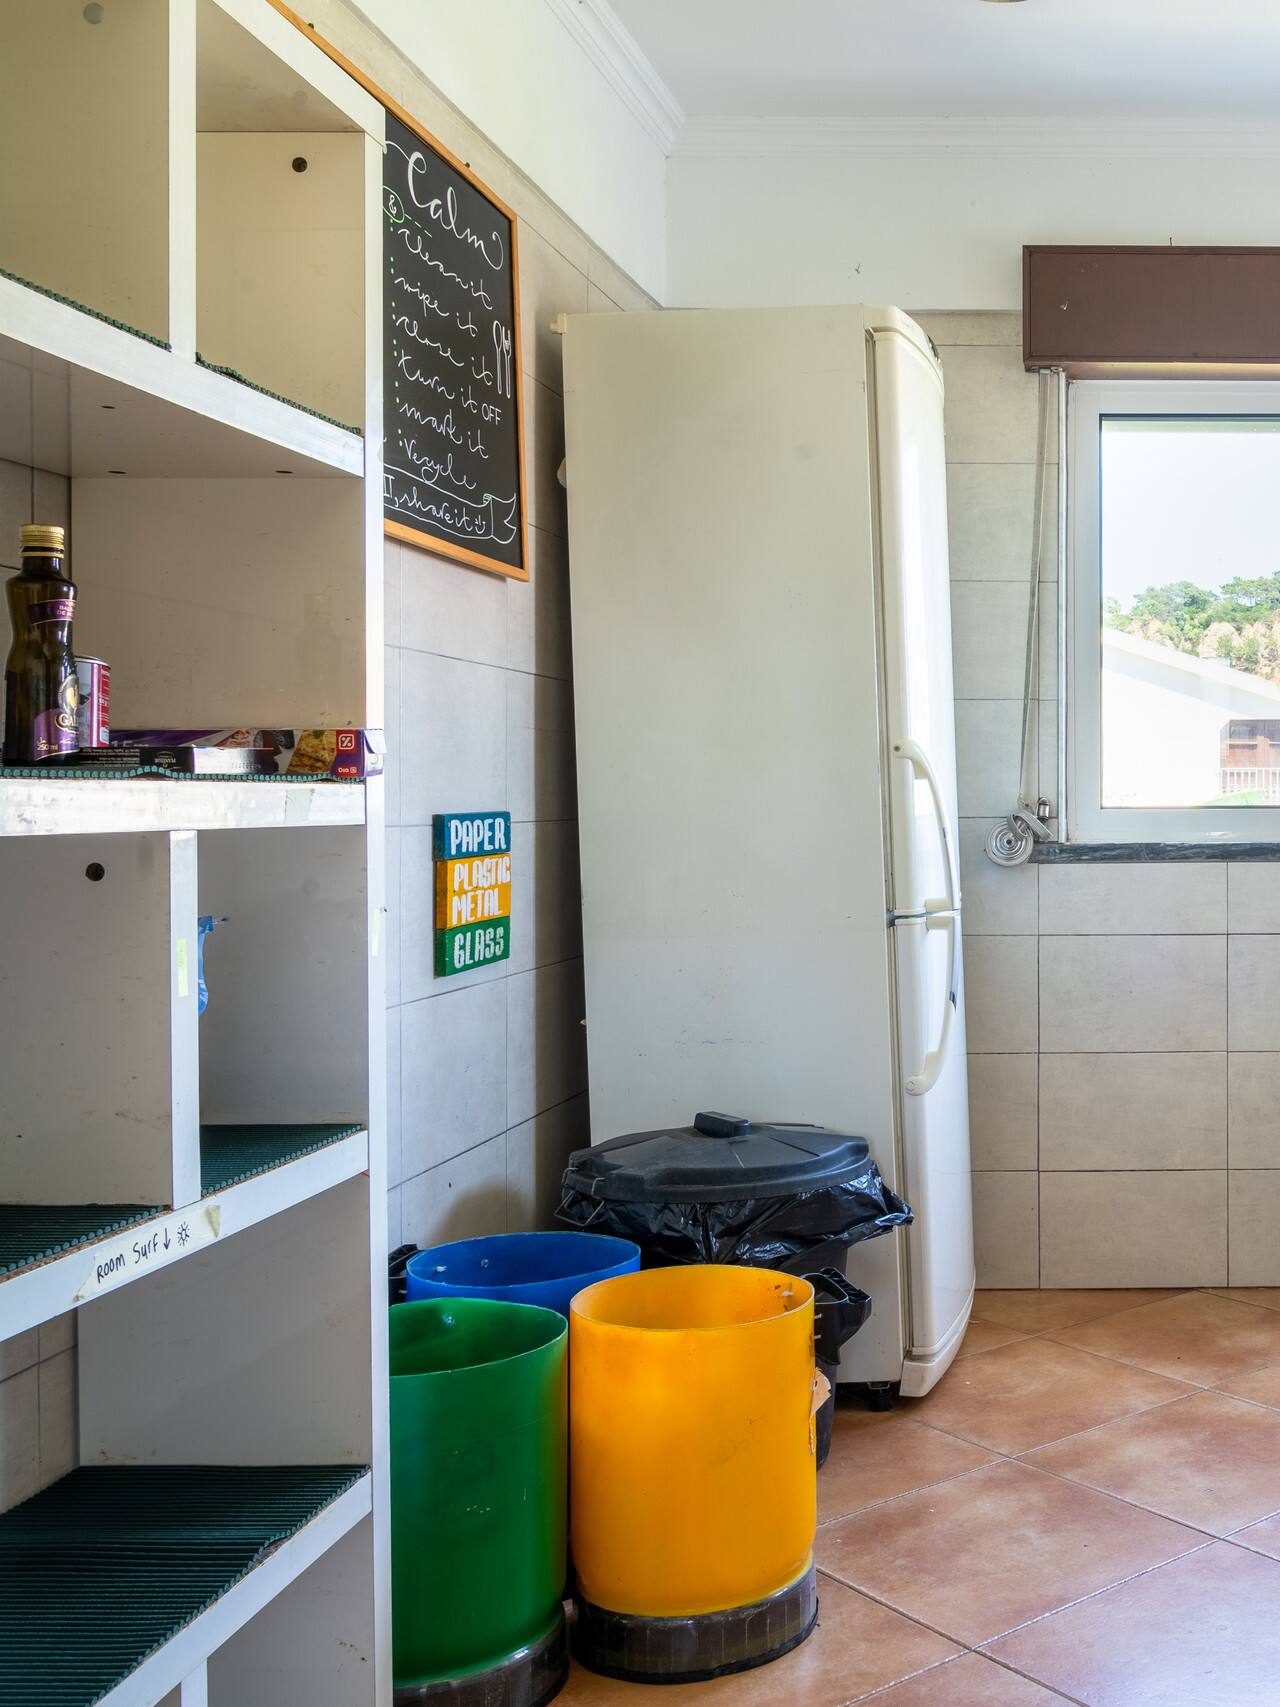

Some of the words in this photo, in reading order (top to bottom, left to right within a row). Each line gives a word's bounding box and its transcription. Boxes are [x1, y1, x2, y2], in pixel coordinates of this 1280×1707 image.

[385, 141, 503, 270] Calm
[394, 277, 450, 318] wipe
[456, 309, 479, 337] it
[470, 280, 493, 310] it
[398, 349, 455, 400] turn
[460, 385, 478, 413] it
[481, 403, 501, 425] OFF
[471, 355, 493, 386] it
[399, 403, 463, 444] mark
[468, 430, 489, 459] it
[450, 817, 507, 856] PAPER
[453, 856, 511, 892] PLASTIC
[451, 887, 503, 926] METAL
[453, 926, 505, 969] GLASS
